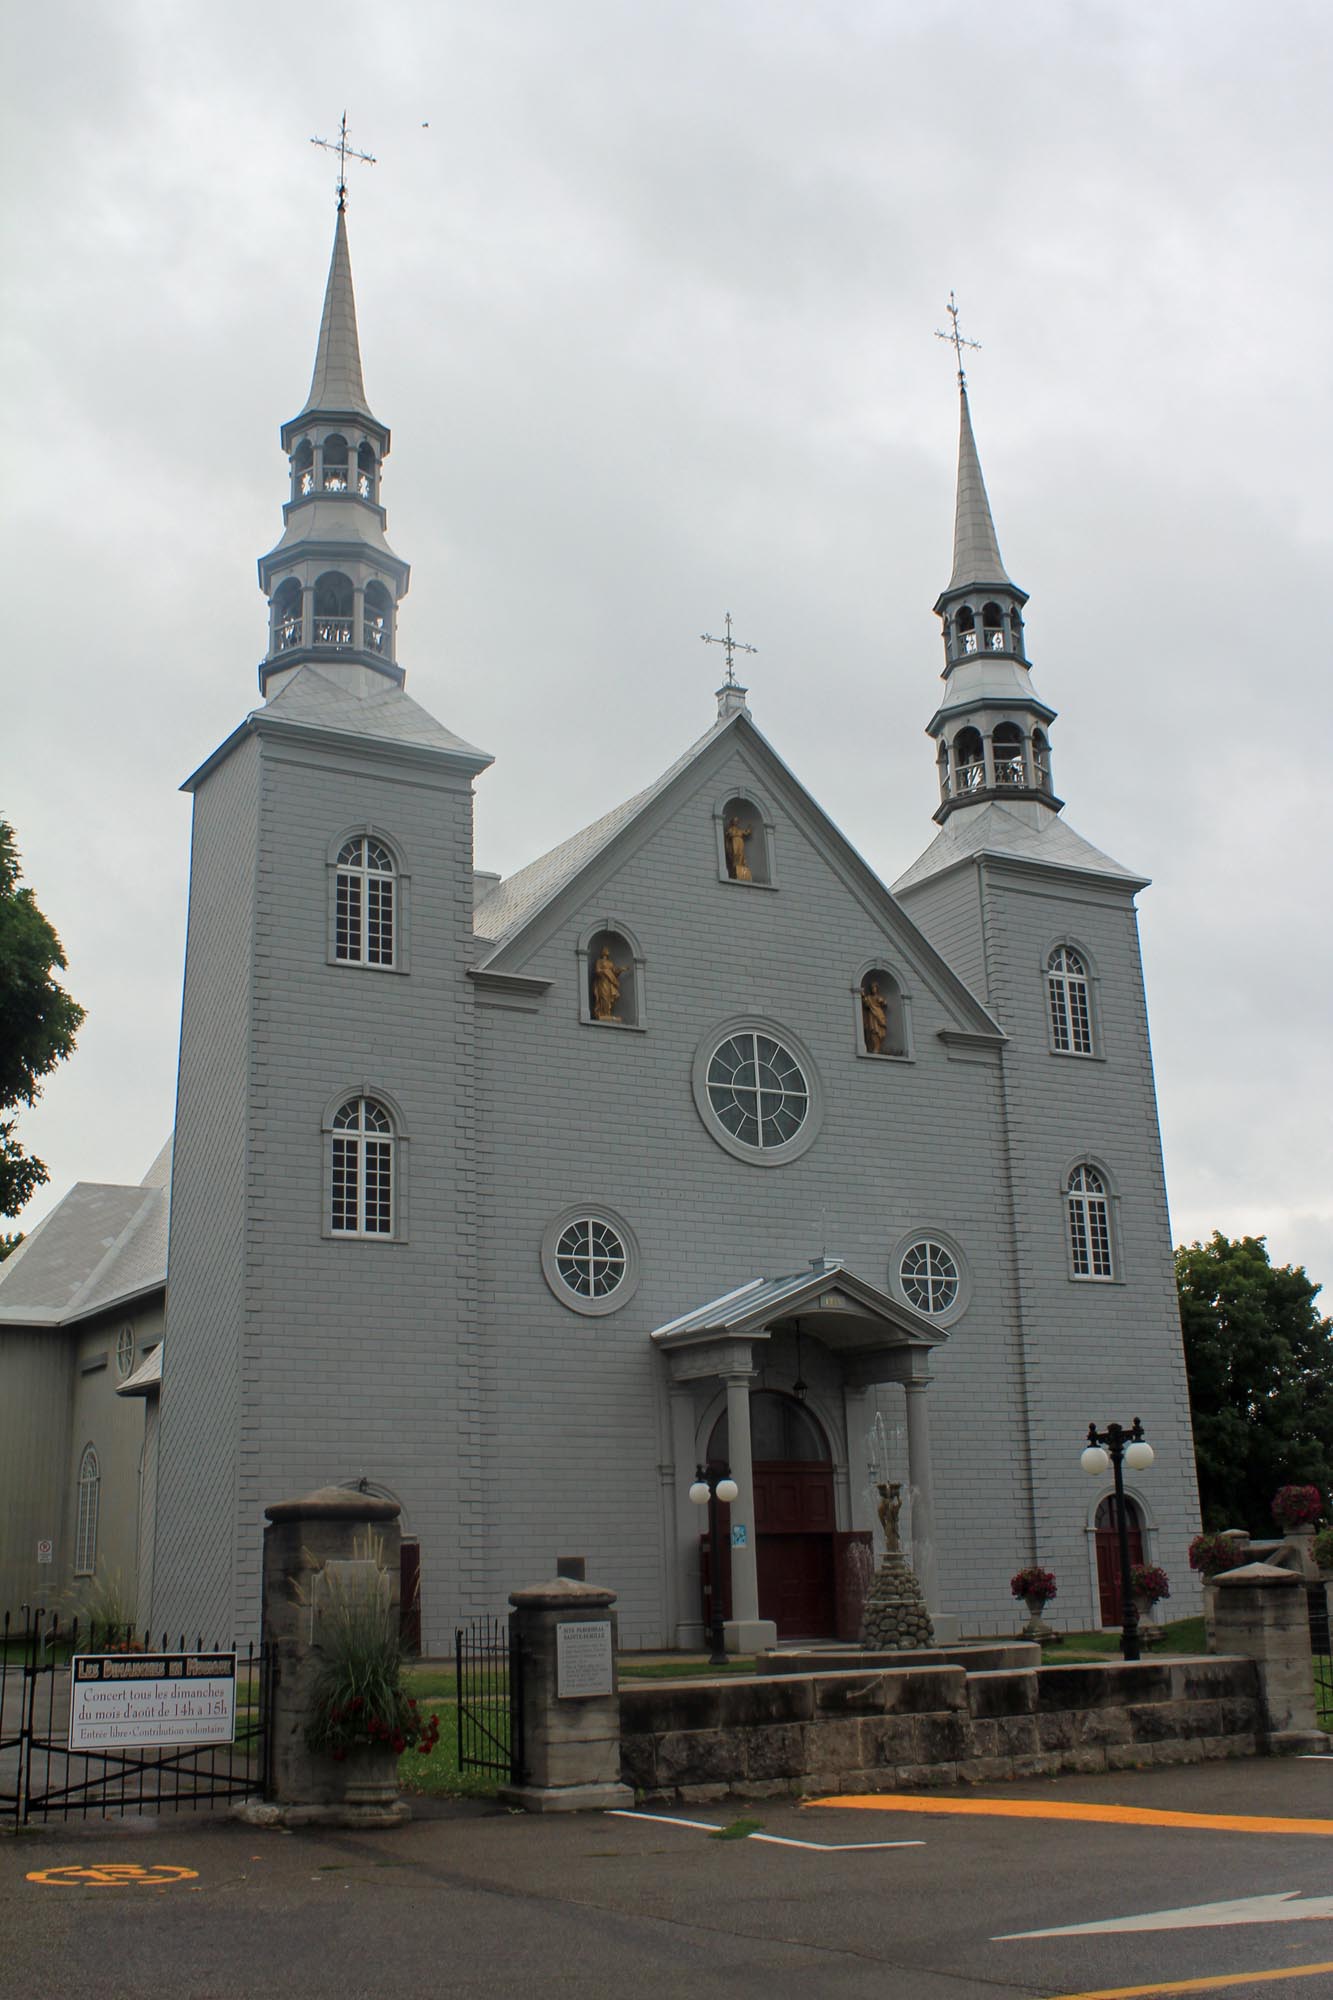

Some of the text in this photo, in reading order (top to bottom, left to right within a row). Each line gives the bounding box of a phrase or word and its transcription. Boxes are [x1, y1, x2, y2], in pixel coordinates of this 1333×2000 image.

[78, 1660, 99, 1679] LES
[103, 1659, 165, 1679] DIMANCHES
[169, 1661, 183, 1677] EN
[83, 1682, 224, 1702] Concert tous les dimanches
[78, 1704, 92, 1720] du
[95, 1706, 121, 1720] mois
[124, 1702, 154, 1718] d'août
[158, 1701, 169, 1717] de
[175, 1700, 194, 1716] 14h
[208, 1699, 227, 1715] 15h
[80, 1721, 225, 1739] Entrée libre Contribution volontaire
